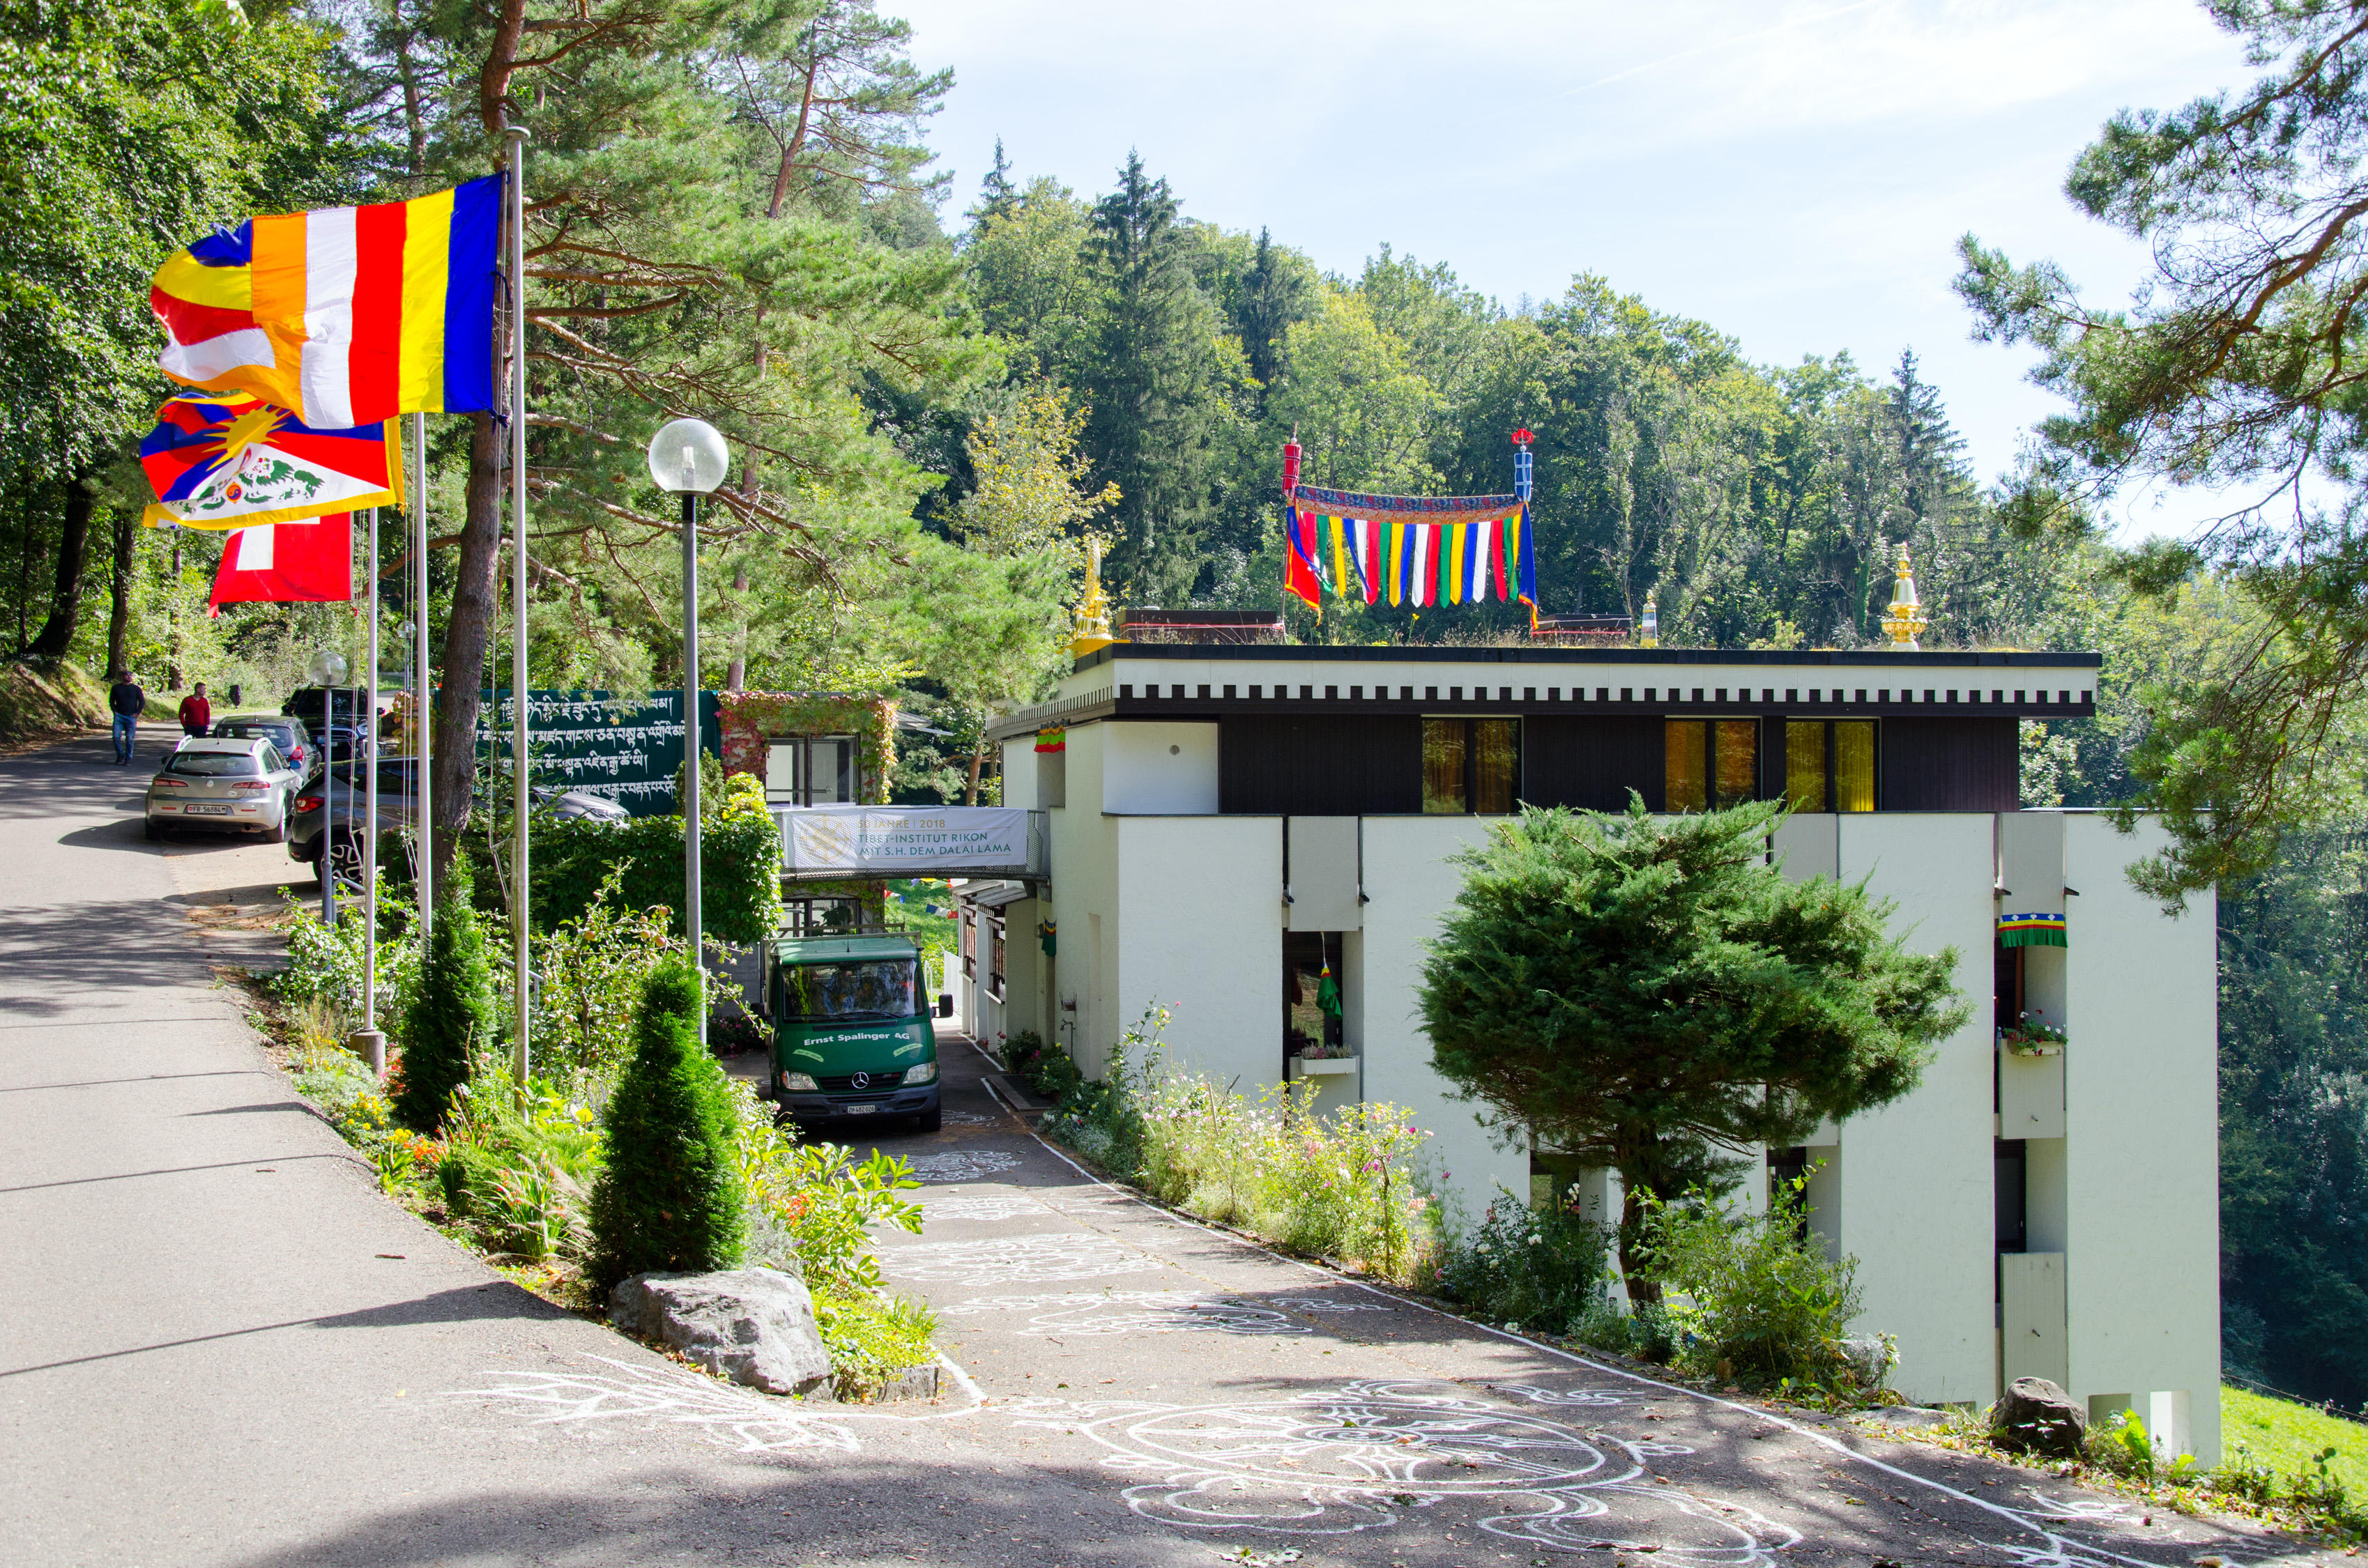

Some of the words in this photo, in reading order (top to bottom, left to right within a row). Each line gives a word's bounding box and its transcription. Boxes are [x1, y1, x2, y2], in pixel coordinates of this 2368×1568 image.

[858, 820, 871, 829] 50
[873, 820, 910, 829] JAHRE
[919, 820, 946, 829] 2018
[858, 833, 948, 843] TIBET-INSTITUT
[951, 832, 988, 843] RIKON
[859, 847, 881, 856] MIT
[885, 847, 907, 856] S.H.
[910, 847, 935, 856] DEM
[939, 845, 974, 854] DALAI
[977, 843, 1012, 853] LAMA
[804, 1036, 834, 1046] Ernst
[837, 1032, 890, 1043] Spalinger
[894, 1032, 910, 1040] AG
